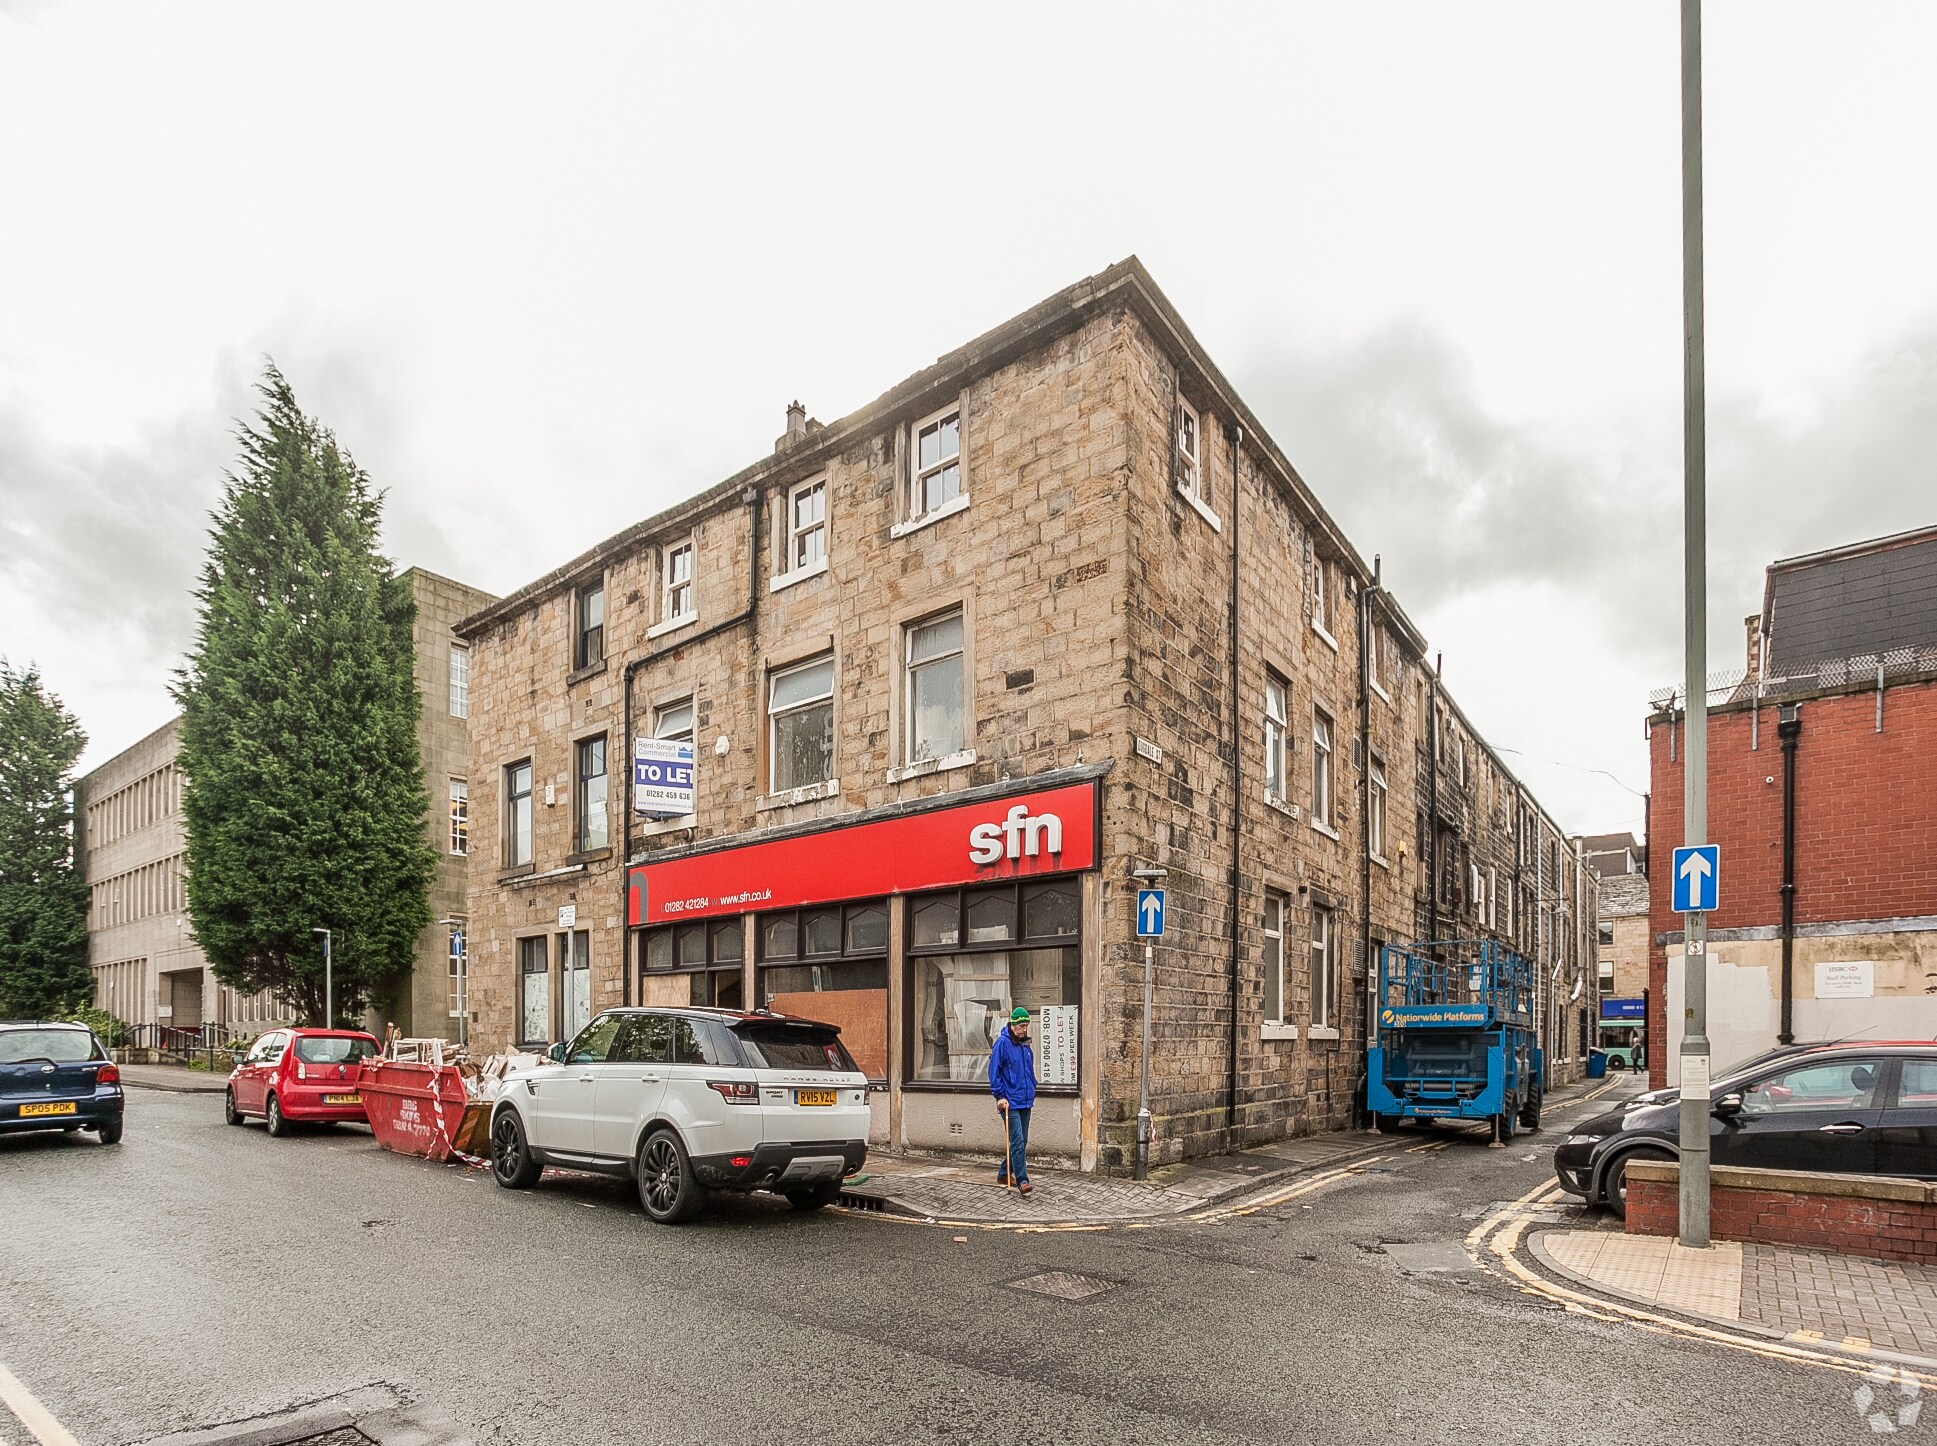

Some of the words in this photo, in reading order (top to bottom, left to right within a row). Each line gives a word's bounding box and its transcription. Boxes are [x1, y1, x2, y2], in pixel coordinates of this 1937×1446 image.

[638, 741, 676, 751] Rent-Smart
[638, 749, 676, 758] Commercial
[638, 765, 661, 781] TO
[667, 767, 693, 784] LET
[647, 790, 663, 799] 01282
[666, 792, 677, 800] 459
[969, 805, 1062, 864] sfn
[665, 901, 683, 912] 01282
[685, 897, 709, 910] 421284
[720, 888, 772, 905] www.sfn.co.uk
[1396, 1013, 1442, 1022] Nationwide
[1443, 1012, 1485, 1021] Platforms
[1058, 1036, 1064, 1049] TO
[801, 1091, 819, 1103] RV15
[820, 1092, 835, 1103] VZL
[25, 1104, 50, 1114] SP05
